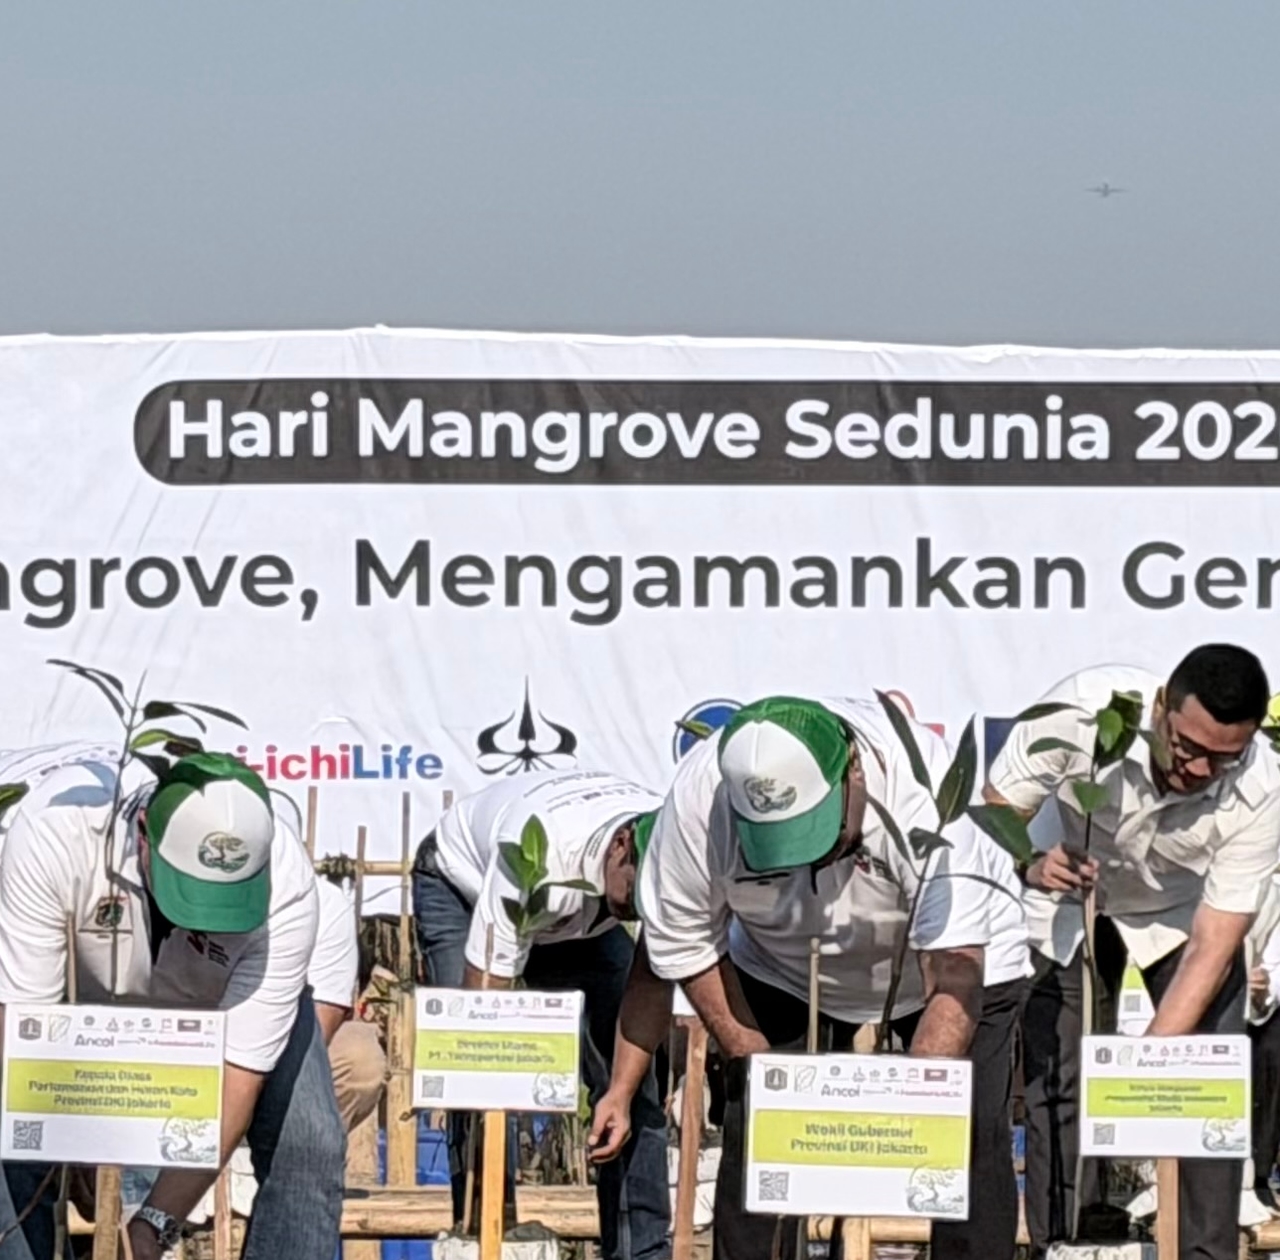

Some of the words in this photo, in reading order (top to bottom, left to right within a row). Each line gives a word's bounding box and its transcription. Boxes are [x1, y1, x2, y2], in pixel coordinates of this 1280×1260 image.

[166, 390, 330, 460] Hari
[357, 396, 762, 474] Mangrove
[784, 394, 1112, 462] Sedunia
[354, 536, 1087, 625] Mengamankan
[74, 1034, 114, 1047] Ancol
[821, 1084, 860, 1097] Ancol
[806, 1123, 845, 1136] Wakil
[848, 1124, 913, 1137] Gubernur
[791, 1139, 846, 1152] Provinsi
[876, 1141, 927, 1155] Jakarta
